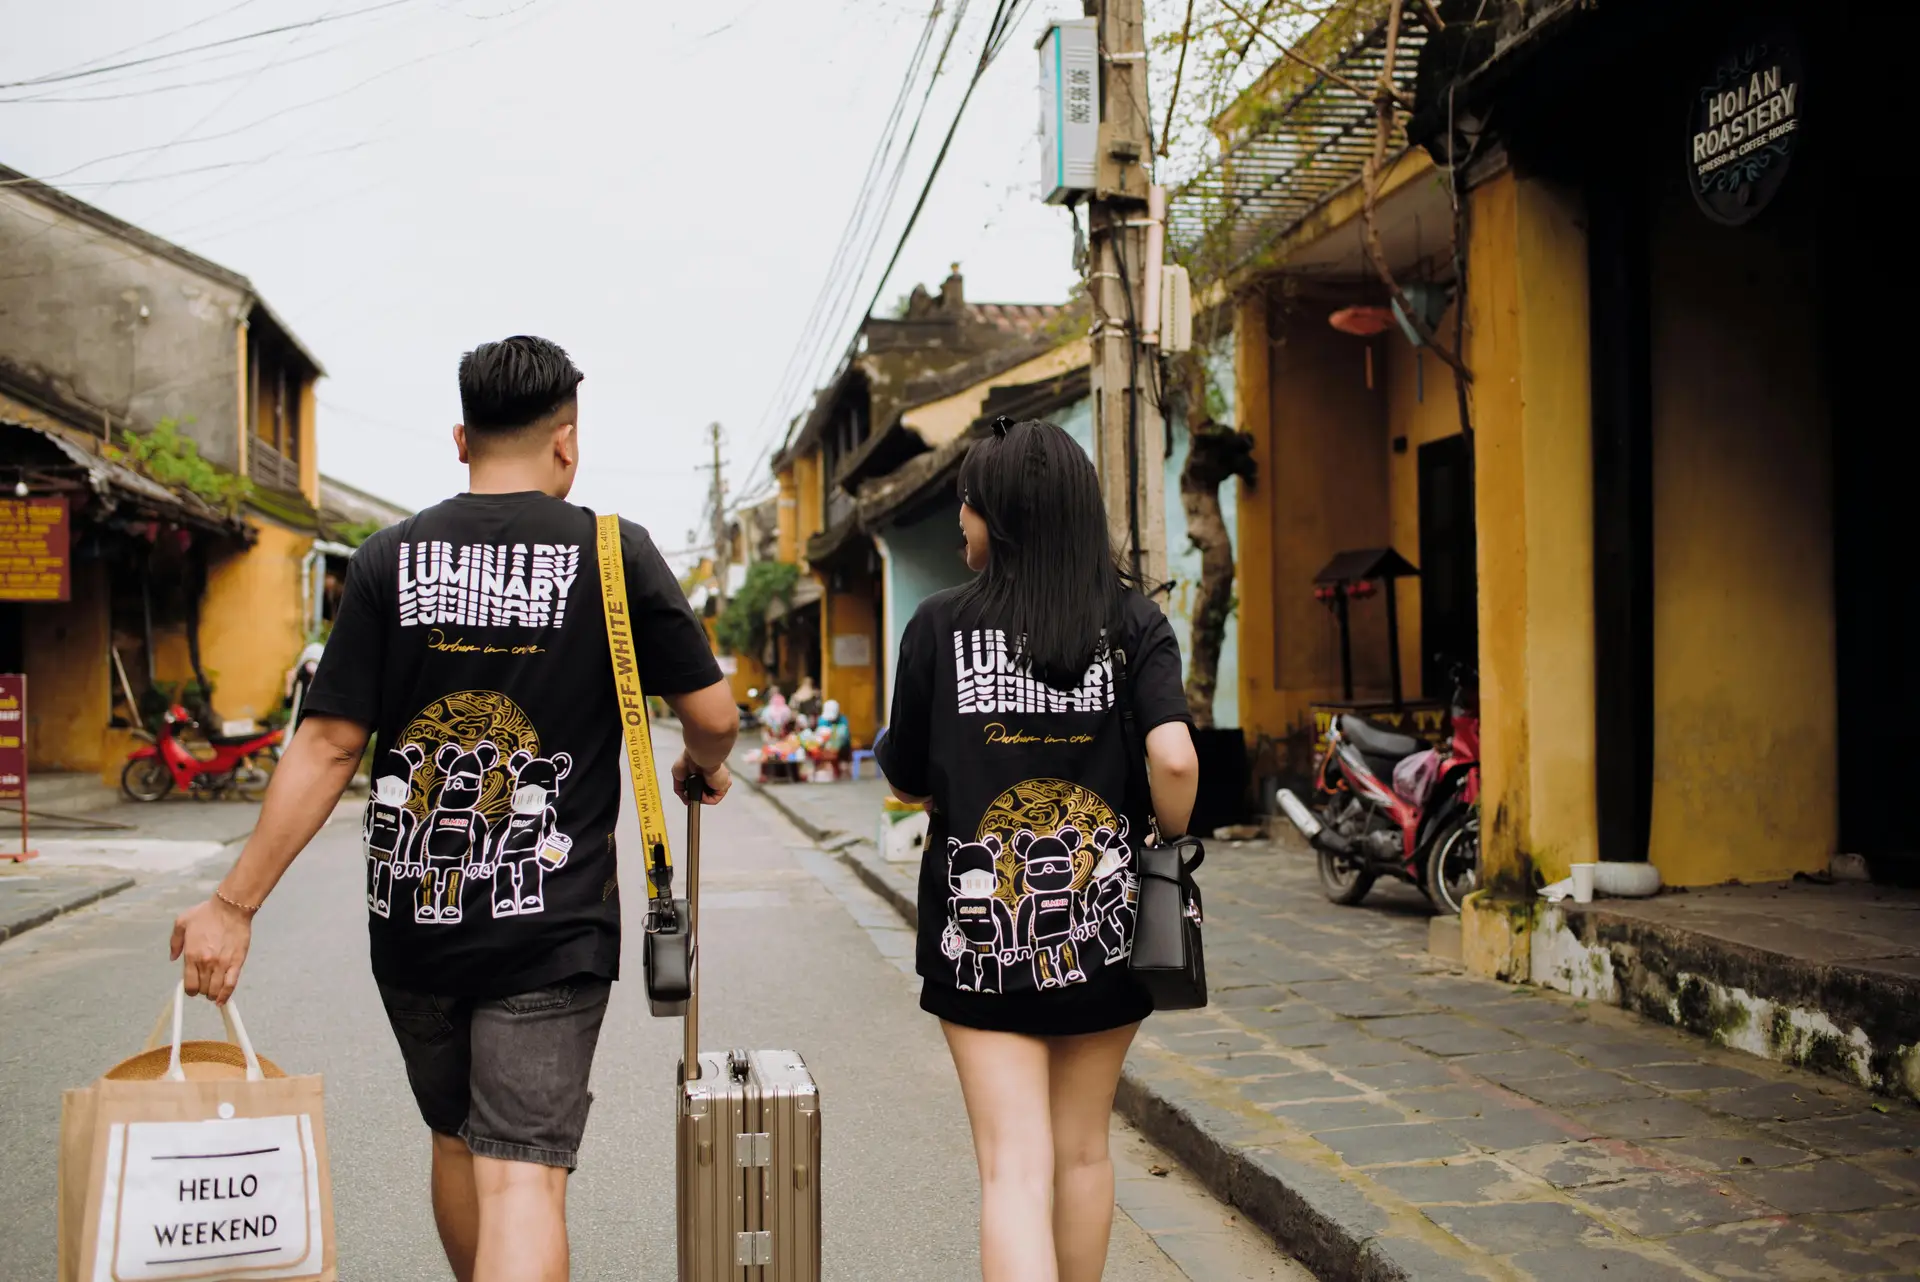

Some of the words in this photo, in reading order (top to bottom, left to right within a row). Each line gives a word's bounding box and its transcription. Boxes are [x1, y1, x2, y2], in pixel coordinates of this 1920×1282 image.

[1708, 86, 1746, 128] HOI
[1747, 66, 1781, 105] AN
[1693, 82, 1797, 164] ROASTERY
[1739, 135, 1769, 157] COFFEE
[1769, 119, 1798, 139] HOUSE
[399, 541, 579, 628] LUMINARY
[602, 556, 612, 581] WILL
[483, 643, 508, 654] in
[953, 628, 1116, 714] LUMIRY
[1043, 733, 1067, 744] in
[1069, 733, 1096, 744] crim
[639, 784, 649, 813] WILL
[648, 787, 657, 814] Weight
[178, 1173, 259, 1203] HELLO
[154, 1214, 278, 1248] WEEKEND
